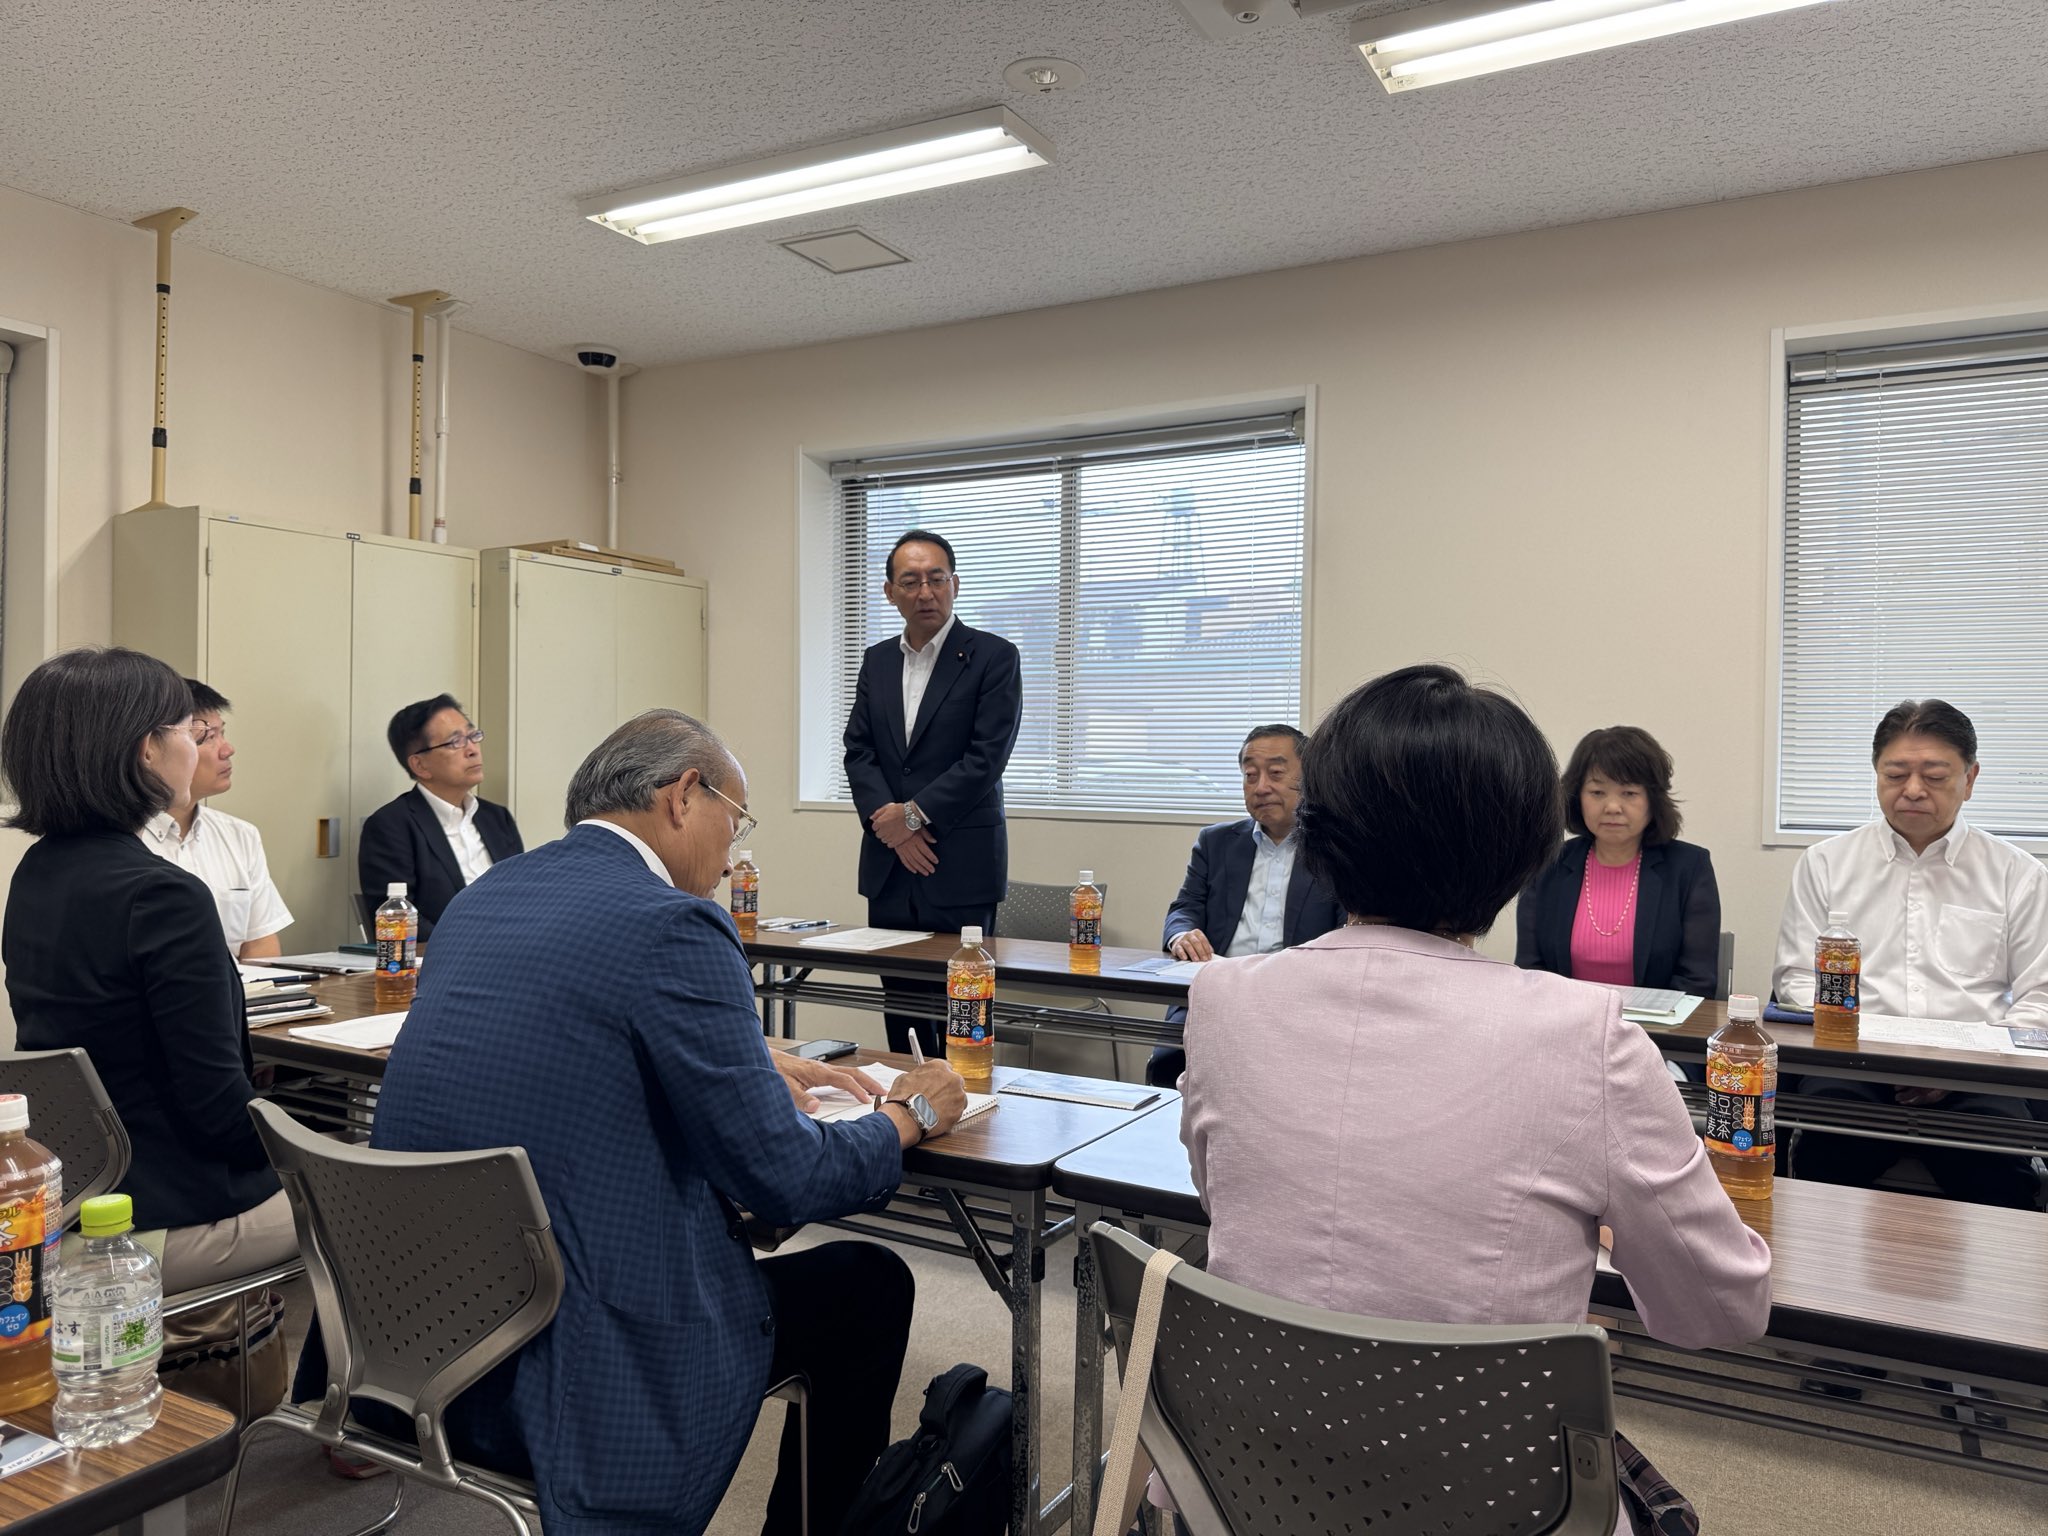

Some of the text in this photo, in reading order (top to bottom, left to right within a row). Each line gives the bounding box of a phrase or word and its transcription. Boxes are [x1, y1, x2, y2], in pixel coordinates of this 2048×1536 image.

[1821, 974, 1842, 989] 黒豆
[953, 984, 980, 997] むぎ茶
[1821, 990, 1842, 1004] 麦茶
[951, 1000, 971, 1016] 黒豆
[950, 1019, 971, 1036] 麦茶
[1710, 1070, 1746, 1091] むぎ茶
[1708, 1090, 1731, 1116] 黒豆
[1706, 1115, 1731, 1139] 麦茶
[6, 1322, 20, 1332] ゼロ
